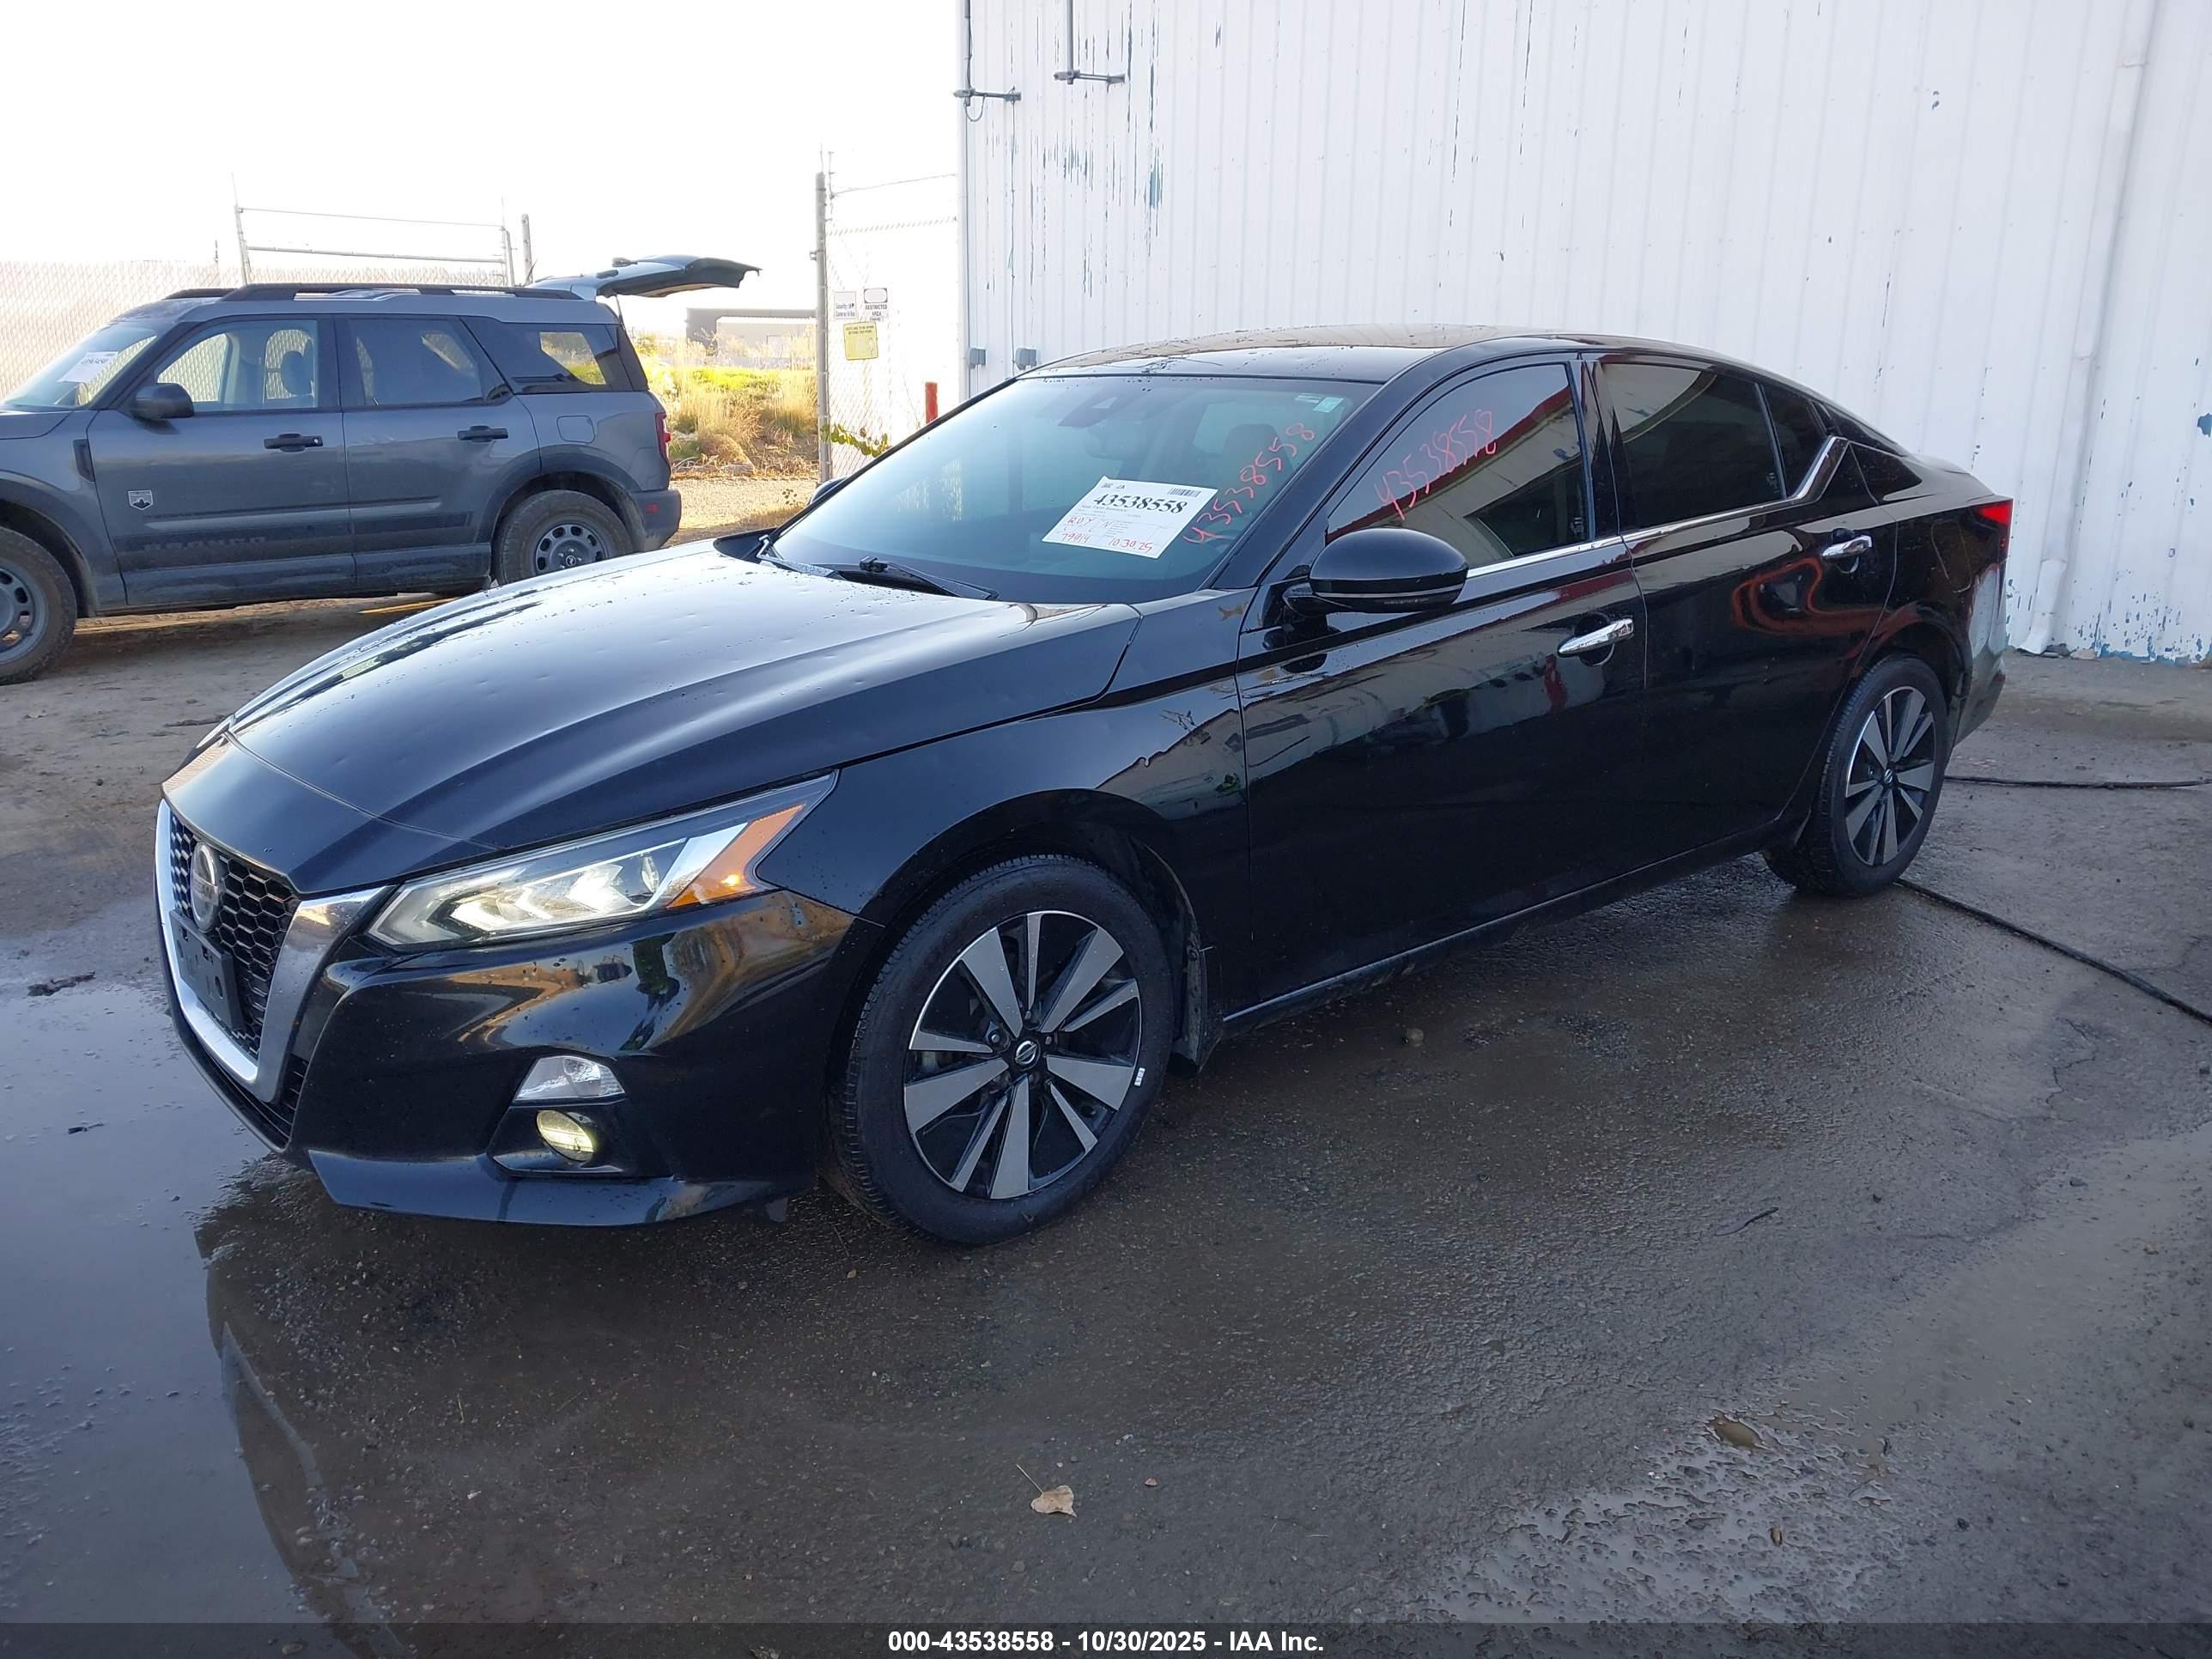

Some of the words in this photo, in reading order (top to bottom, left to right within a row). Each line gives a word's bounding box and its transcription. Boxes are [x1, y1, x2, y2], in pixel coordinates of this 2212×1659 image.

[1093, 493, 1188, 514] 43538558
[1182, 422, 1316, 544] 43538558
[1373, 409, 1497, 521] 43538558
